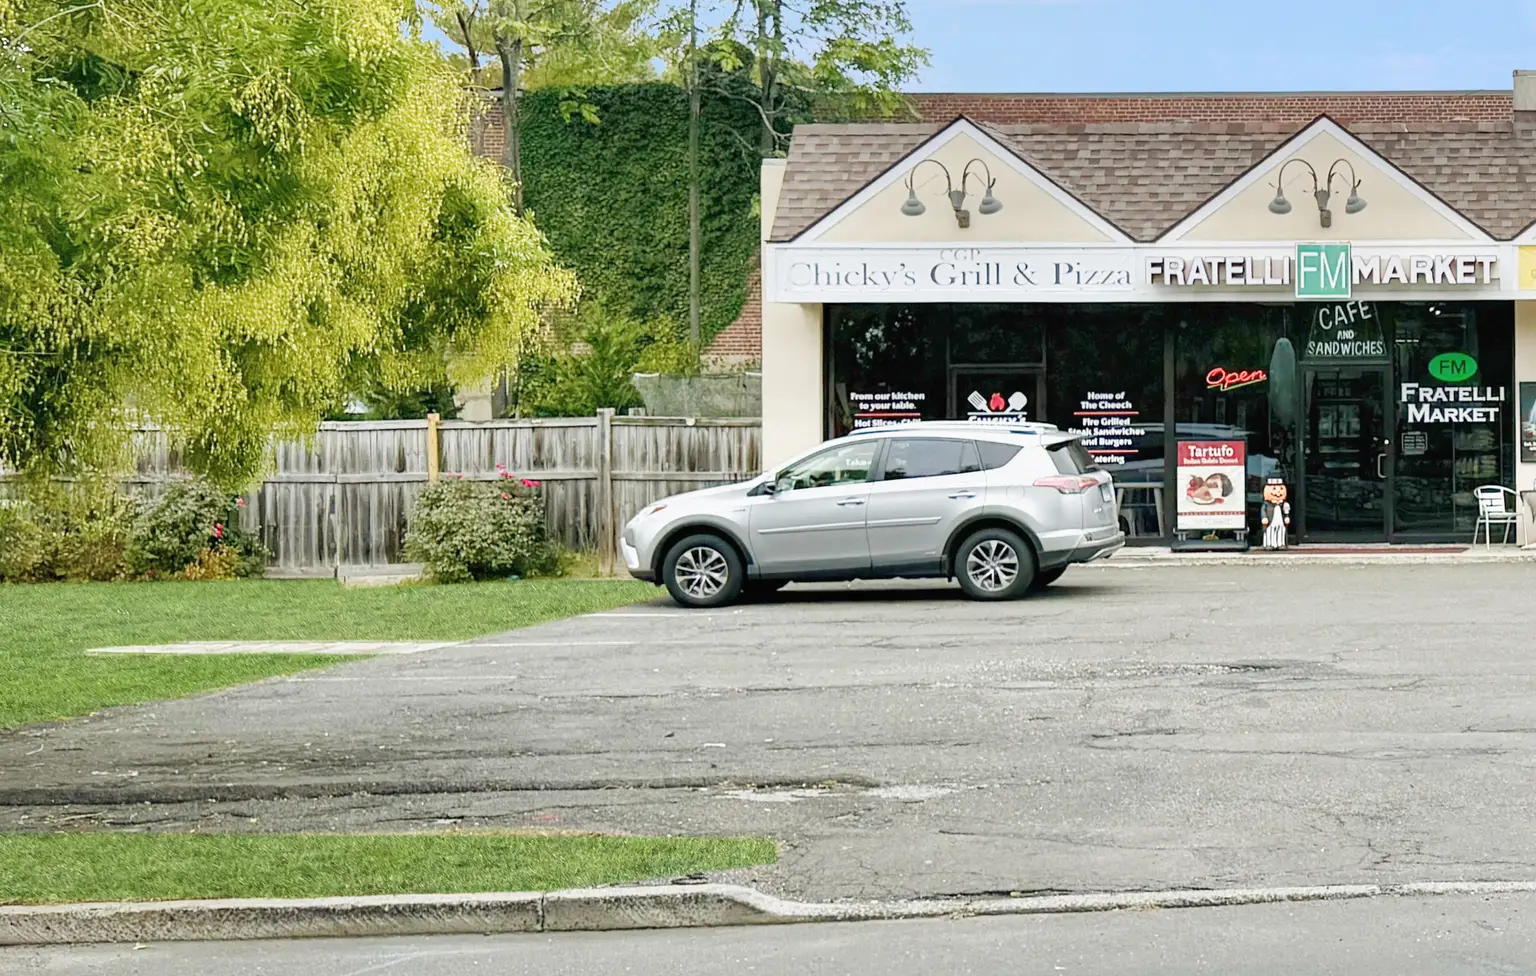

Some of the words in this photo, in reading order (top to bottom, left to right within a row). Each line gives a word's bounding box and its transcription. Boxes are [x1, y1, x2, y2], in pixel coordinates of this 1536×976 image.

[790, 262, 916, 291] Chicky's
[929, 262, 1001, 287] Grill
[1012, 262, 1038, 287] &
[1053, 262, 1132, 286] Pizza
[1145, 256, 1290, 285] FRATELLI
[1299, 251, 1347, 290] FM
[1353, 255, 1497, 284] MARKET
[1318, 300, 1373, 330] CAFE
[1337, 329, 1355, 341] AND
[1308, 340, 1384, 356] SANDWICHES
[1439, 359, 1467, 375] FM
[1206, 367, 1267, 389] Open
[850, 392, 874, 401] From
[874, 393, 890, 401] our
[891, 391, 926, 400] kitchen
[1087, 391, 1114, 400] Home
[1401, 382, 1505, 402] FRATELLI
[1080, 401, 1098, 410] The
[1408, 403, 1499, 423] MARKET
[1091, 454, 1126, 464] atering
[1187, 444, 1235, 458] Tartufo
